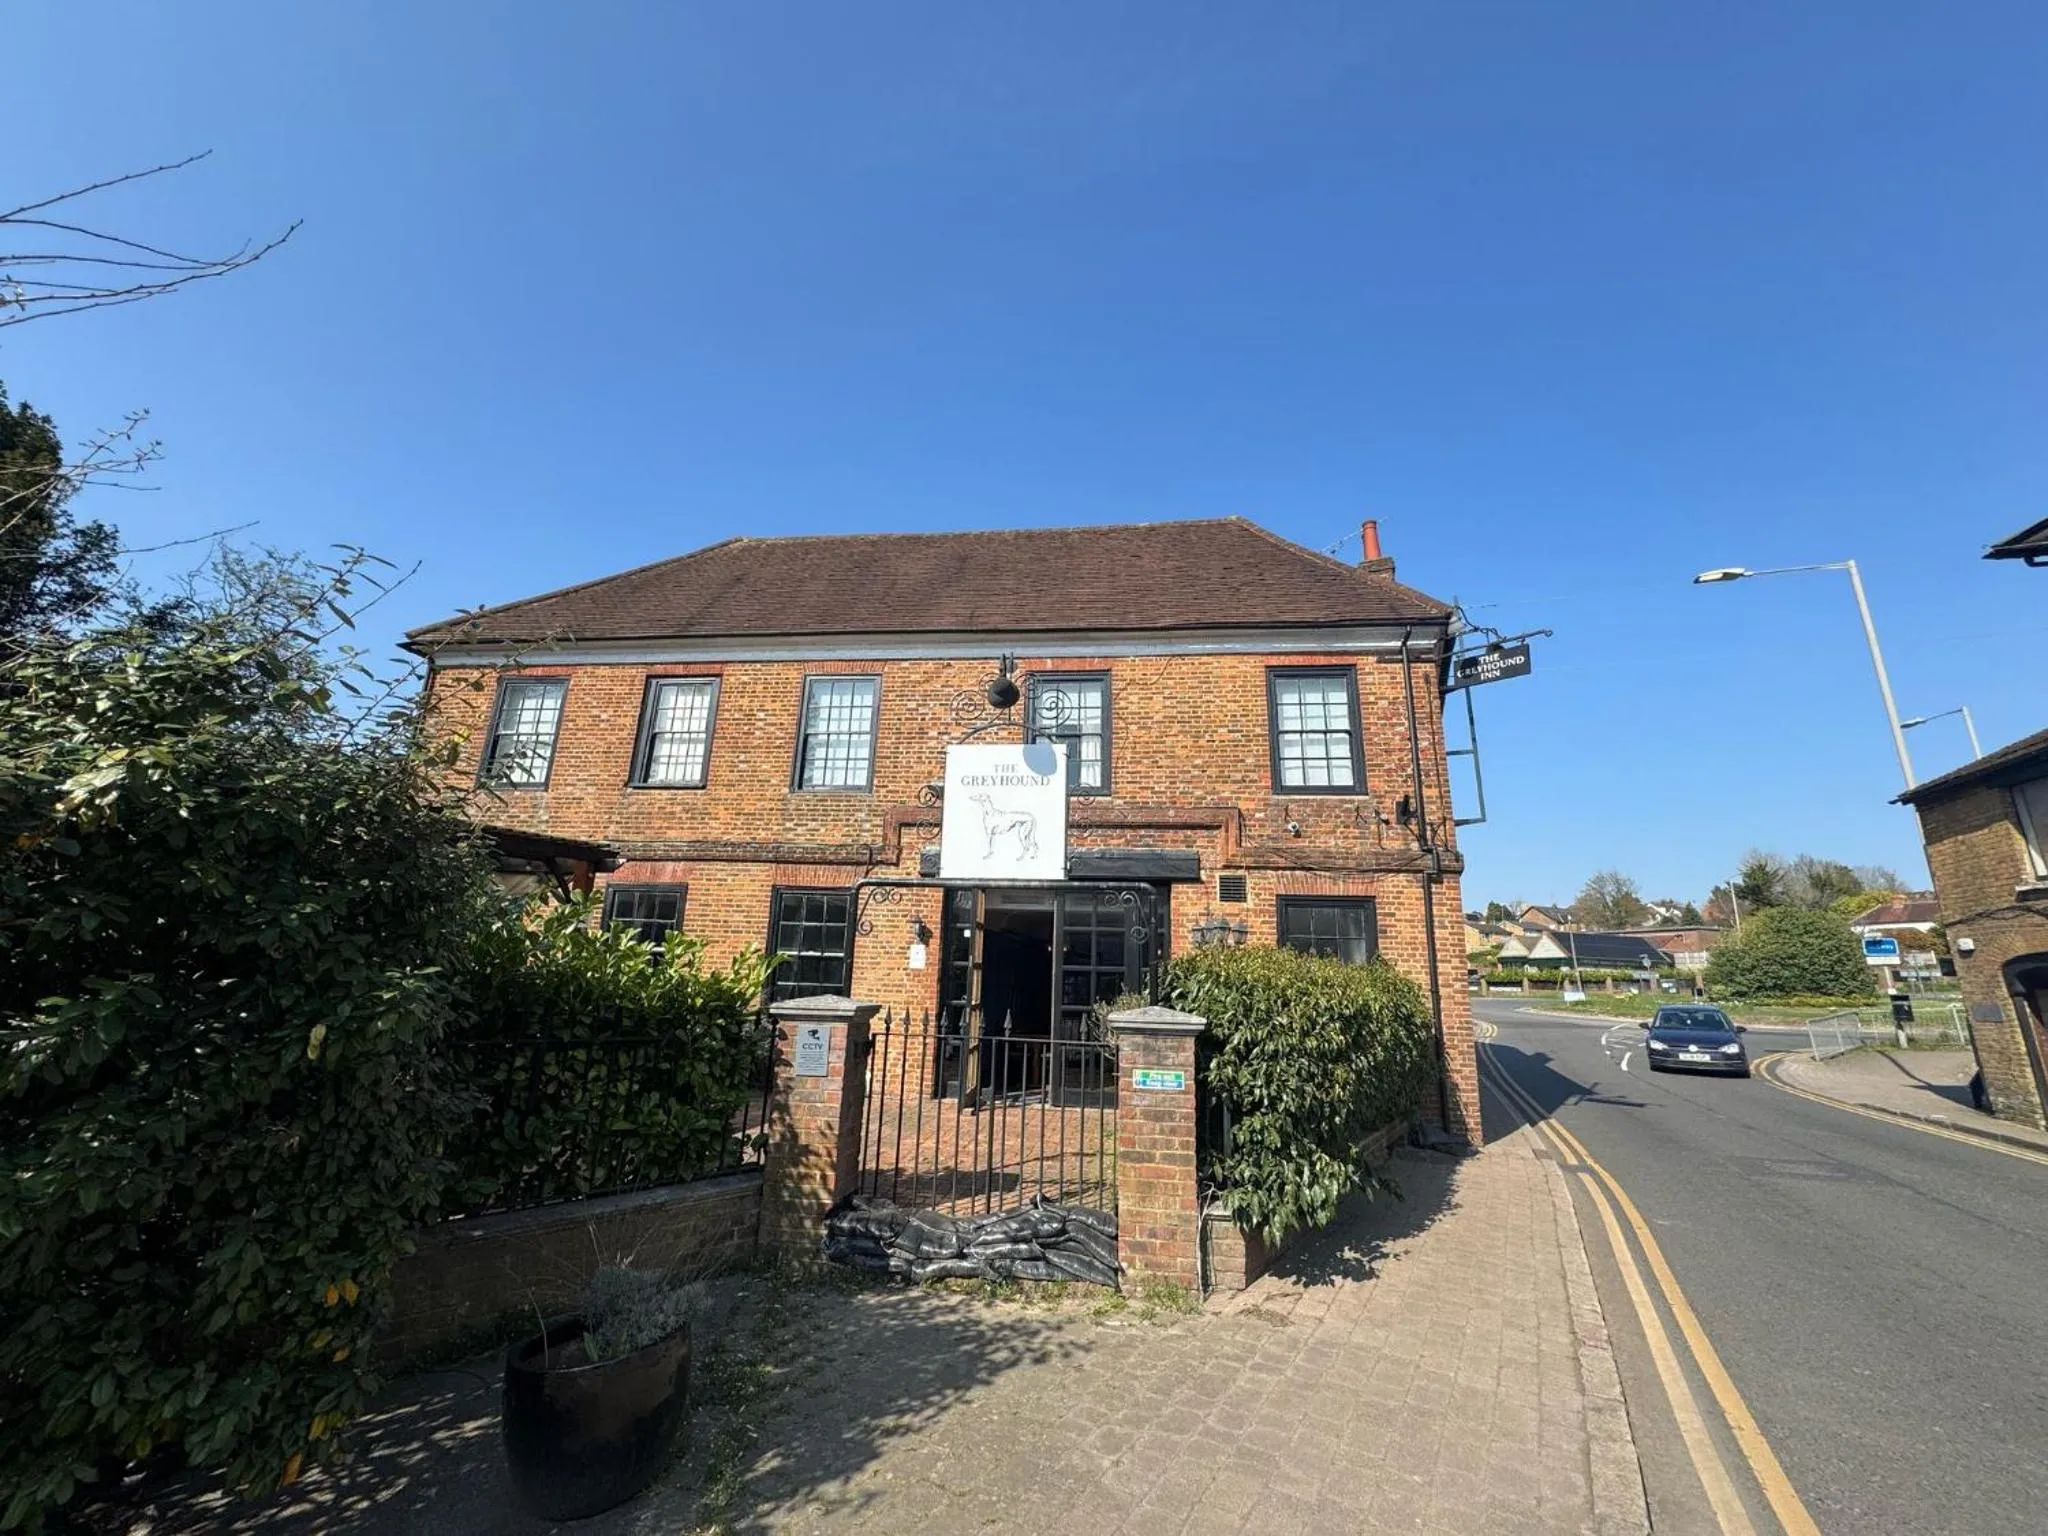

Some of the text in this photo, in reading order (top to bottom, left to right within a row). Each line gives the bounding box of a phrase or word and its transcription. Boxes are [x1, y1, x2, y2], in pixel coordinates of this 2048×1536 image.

[1479, 653, 1500, 664] THE
[1480, 670, 1500, 680] INN
[994, 764, 1019, 773] THE
[960, 775, 1050, 787] GREYHOUND
[802, 1043, 824, 1051] CCTV
